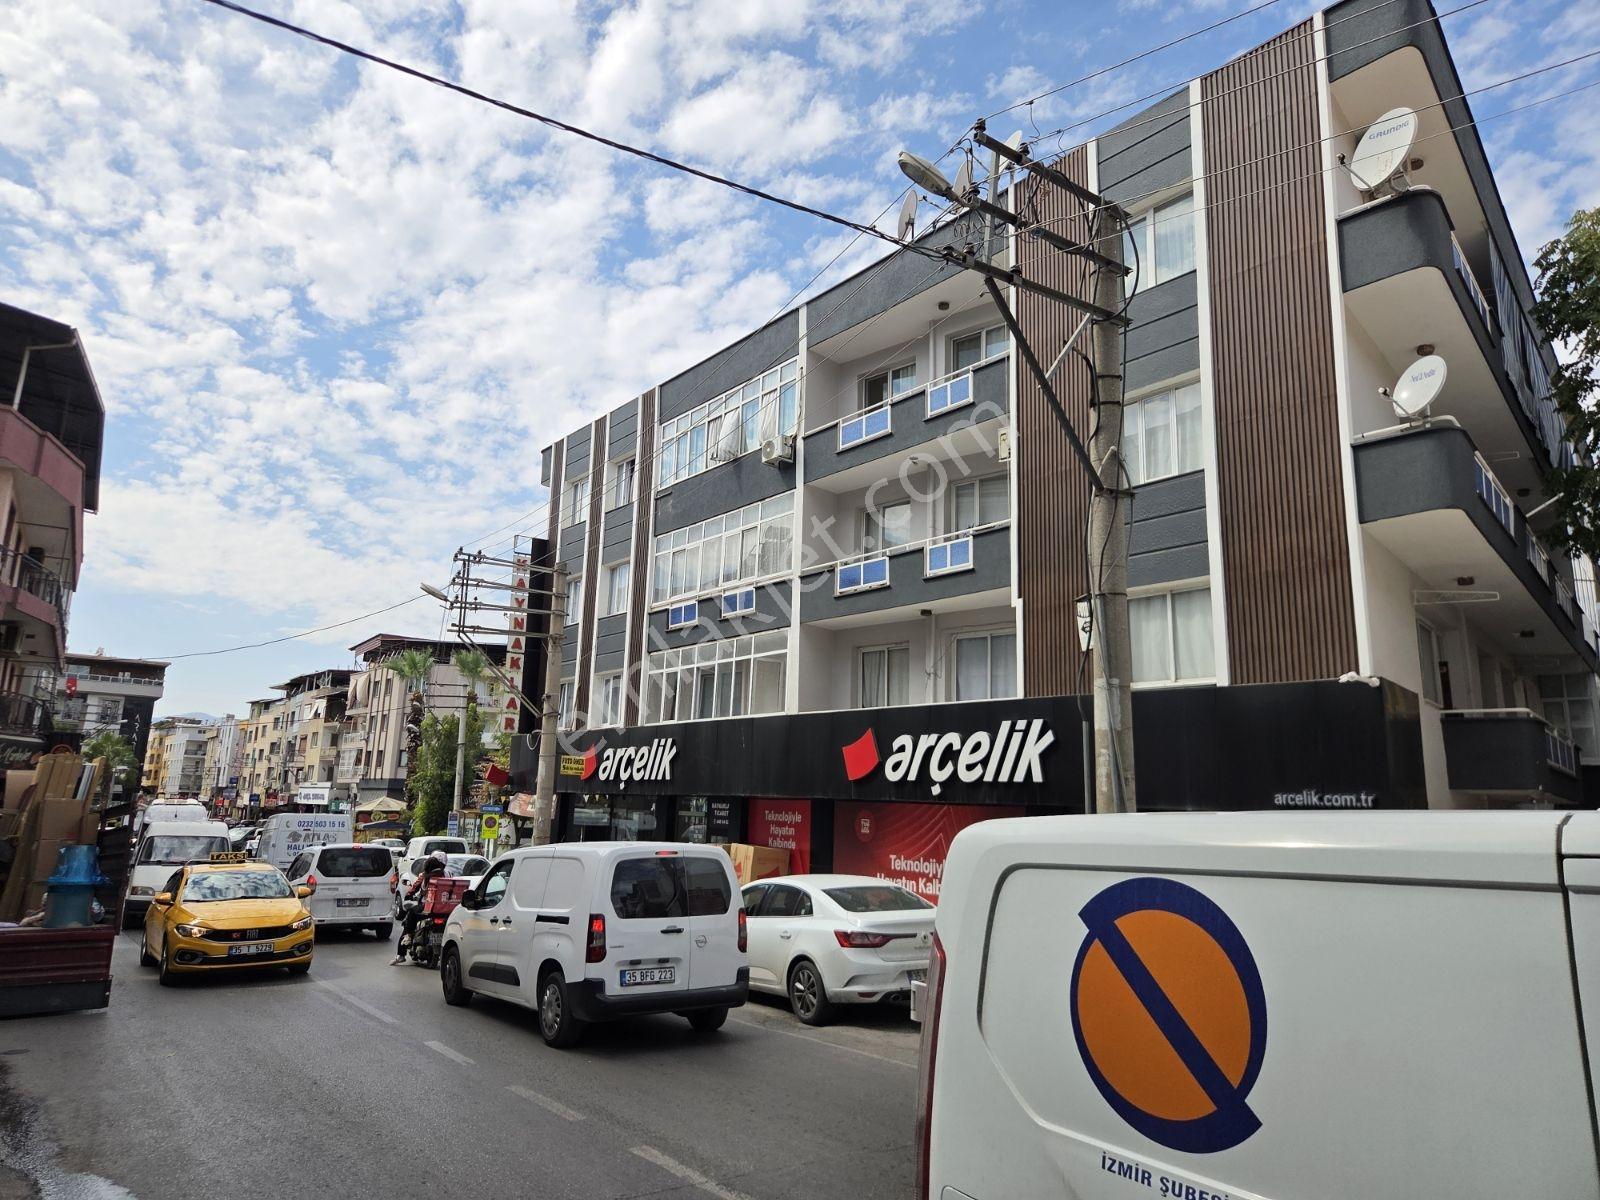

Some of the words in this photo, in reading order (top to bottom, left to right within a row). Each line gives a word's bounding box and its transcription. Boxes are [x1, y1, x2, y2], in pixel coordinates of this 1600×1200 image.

[1369, 120, 1409, 140] GRUNDIG
[598, 738, 677, 790] arçelik
[885, 719, 1054, 796] arçelik
[1274, 789, 1376, 807] arcelik.com.tr
[765, 810, 802, 822] Teknolojiyle
[889, 854, 946, 878] Teknolojiy
[919, 877, 941, 895] Kalb
[233, 946, 241, 954] 35
[626, 971, 637, 982] 35
[640, 970, 655, 981] BFG
[658, 969, 673, 980] 223
[1101, 1151, 1152, 1188] İZMİR
